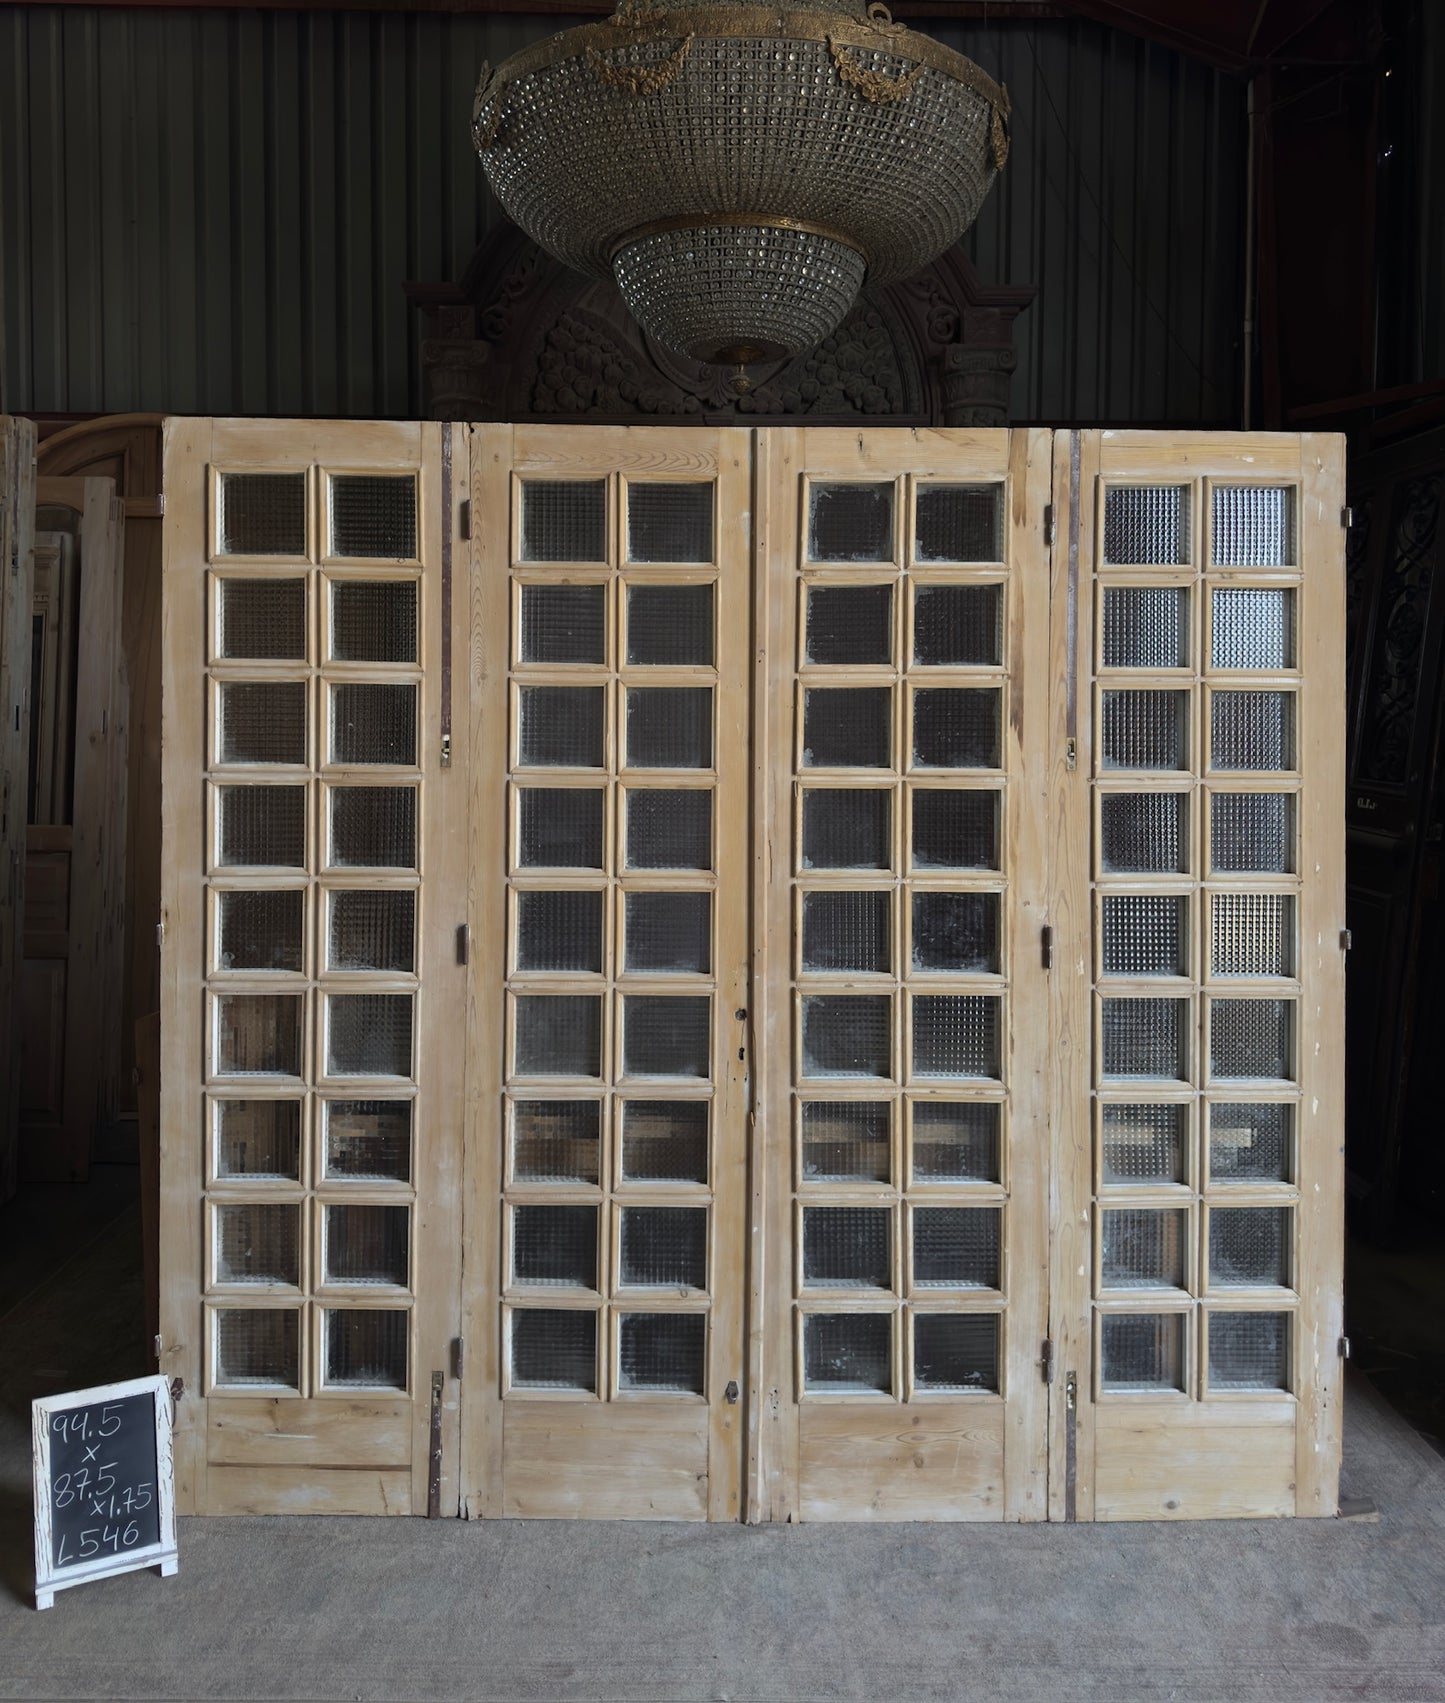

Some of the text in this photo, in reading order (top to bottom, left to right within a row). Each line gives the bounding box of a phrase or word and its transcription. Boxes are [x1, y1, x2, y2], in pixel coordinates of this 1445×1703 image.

[53, 1405, 125, 1443] 94.5
[54, 1463, 118, 1508] 87.5
[58, 1520, 138, 1565] L546
